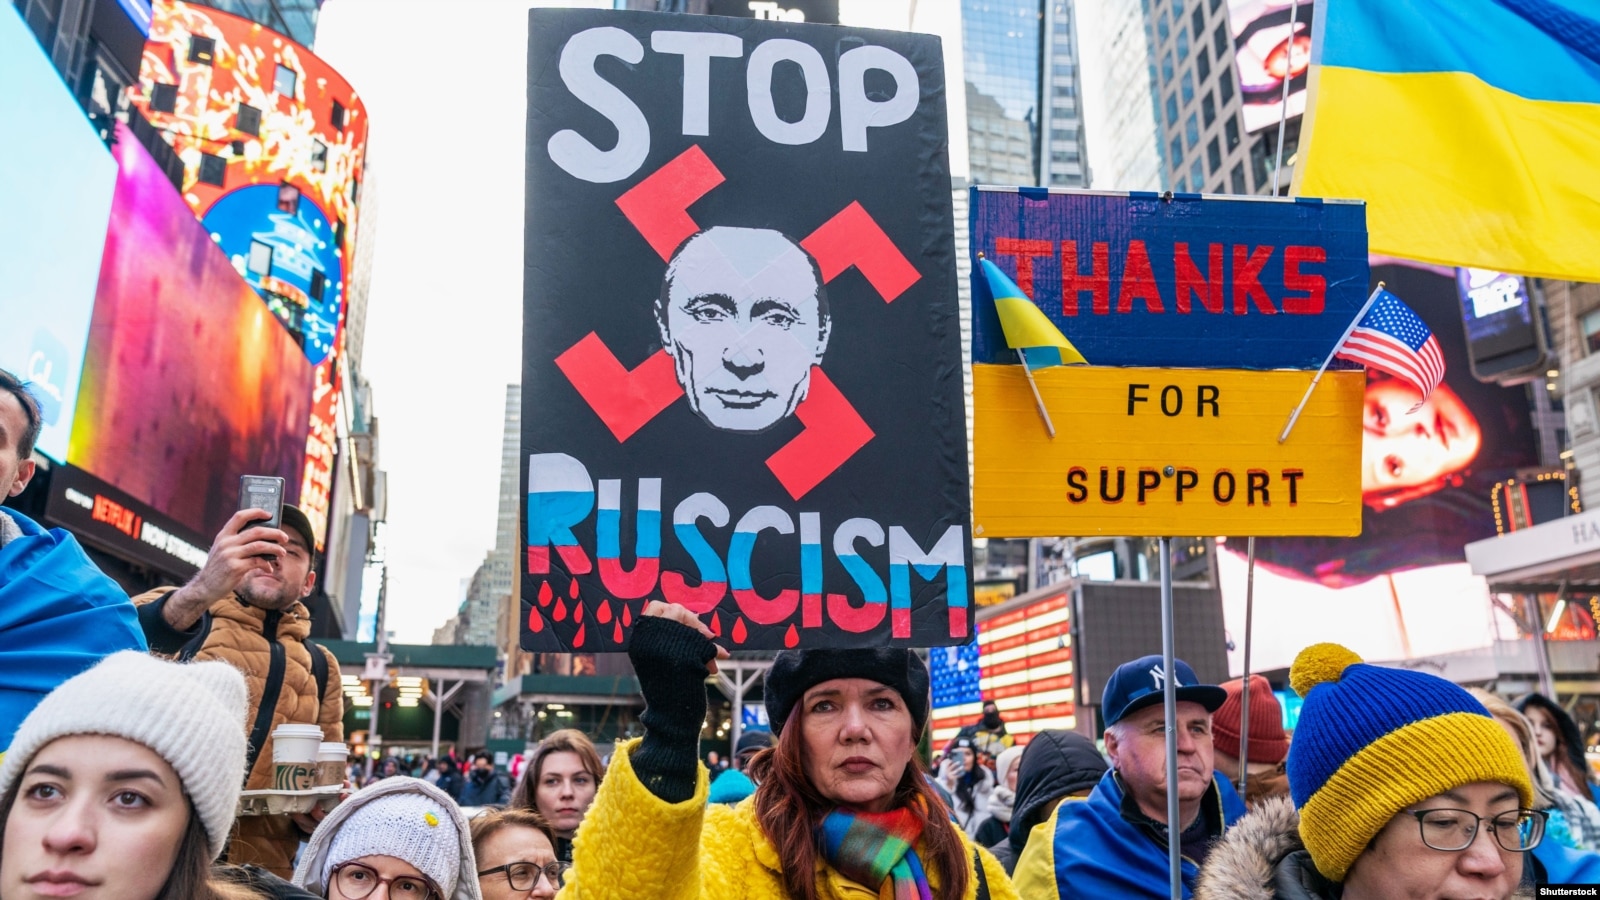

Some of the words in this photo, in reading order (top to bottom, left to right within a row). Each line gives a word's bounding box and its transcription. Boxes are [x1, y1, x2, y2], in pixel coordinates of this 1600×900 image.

[547, 26, 920, 183] STOP
[995, 237, 1327, 316] THANKS
[1127, 383, 1220, 418] FOR
[91, 493, 136, 536] NETFLIX
[1066, 466, 1305, 507] SUPPORT
[527, 452, 968, 638] RUSCISM
